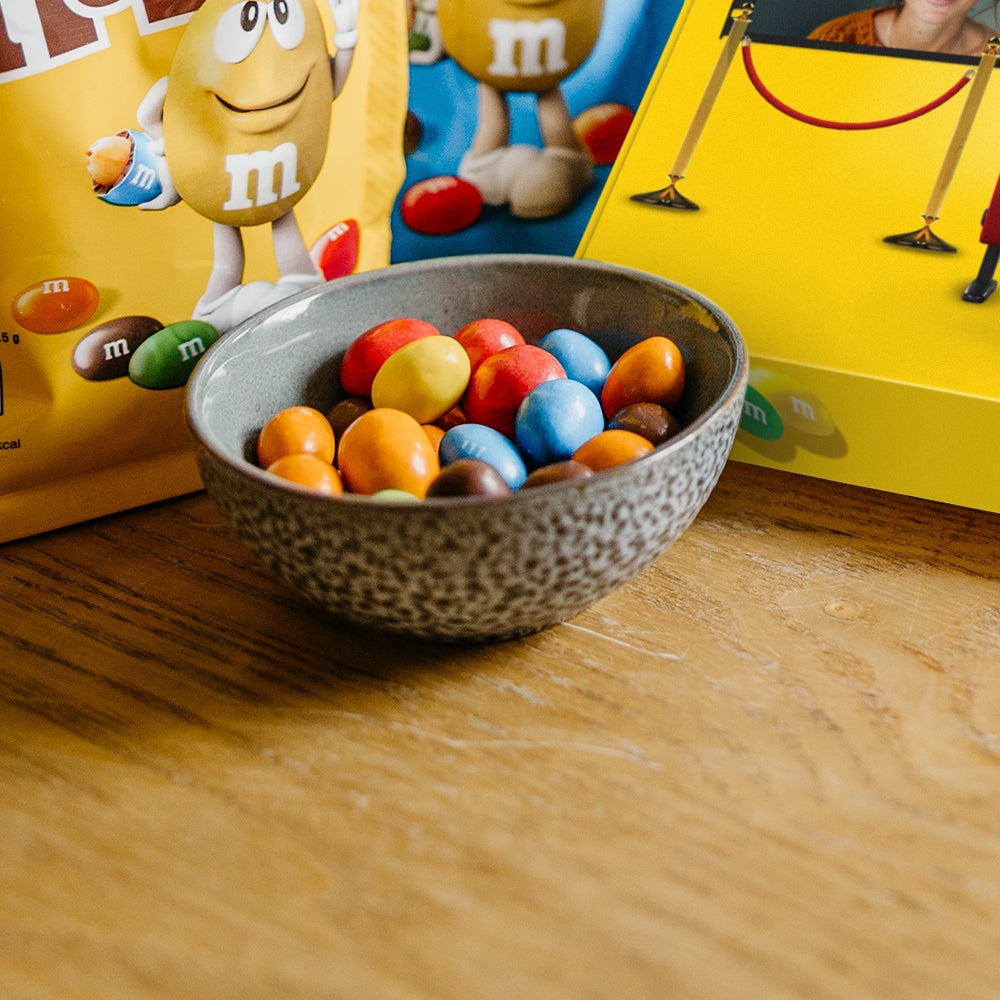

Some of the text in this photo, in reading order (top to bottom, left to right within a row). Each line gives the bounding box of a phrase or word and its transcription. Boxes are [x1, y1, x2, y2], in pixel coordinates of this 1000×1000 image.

[488, 16, 569, 78] m
[222, 141, 301, 212] m
[41, 278, 71, 295] m
[103, 337, 130, 361] m
[178, 336, 206, 362] m
